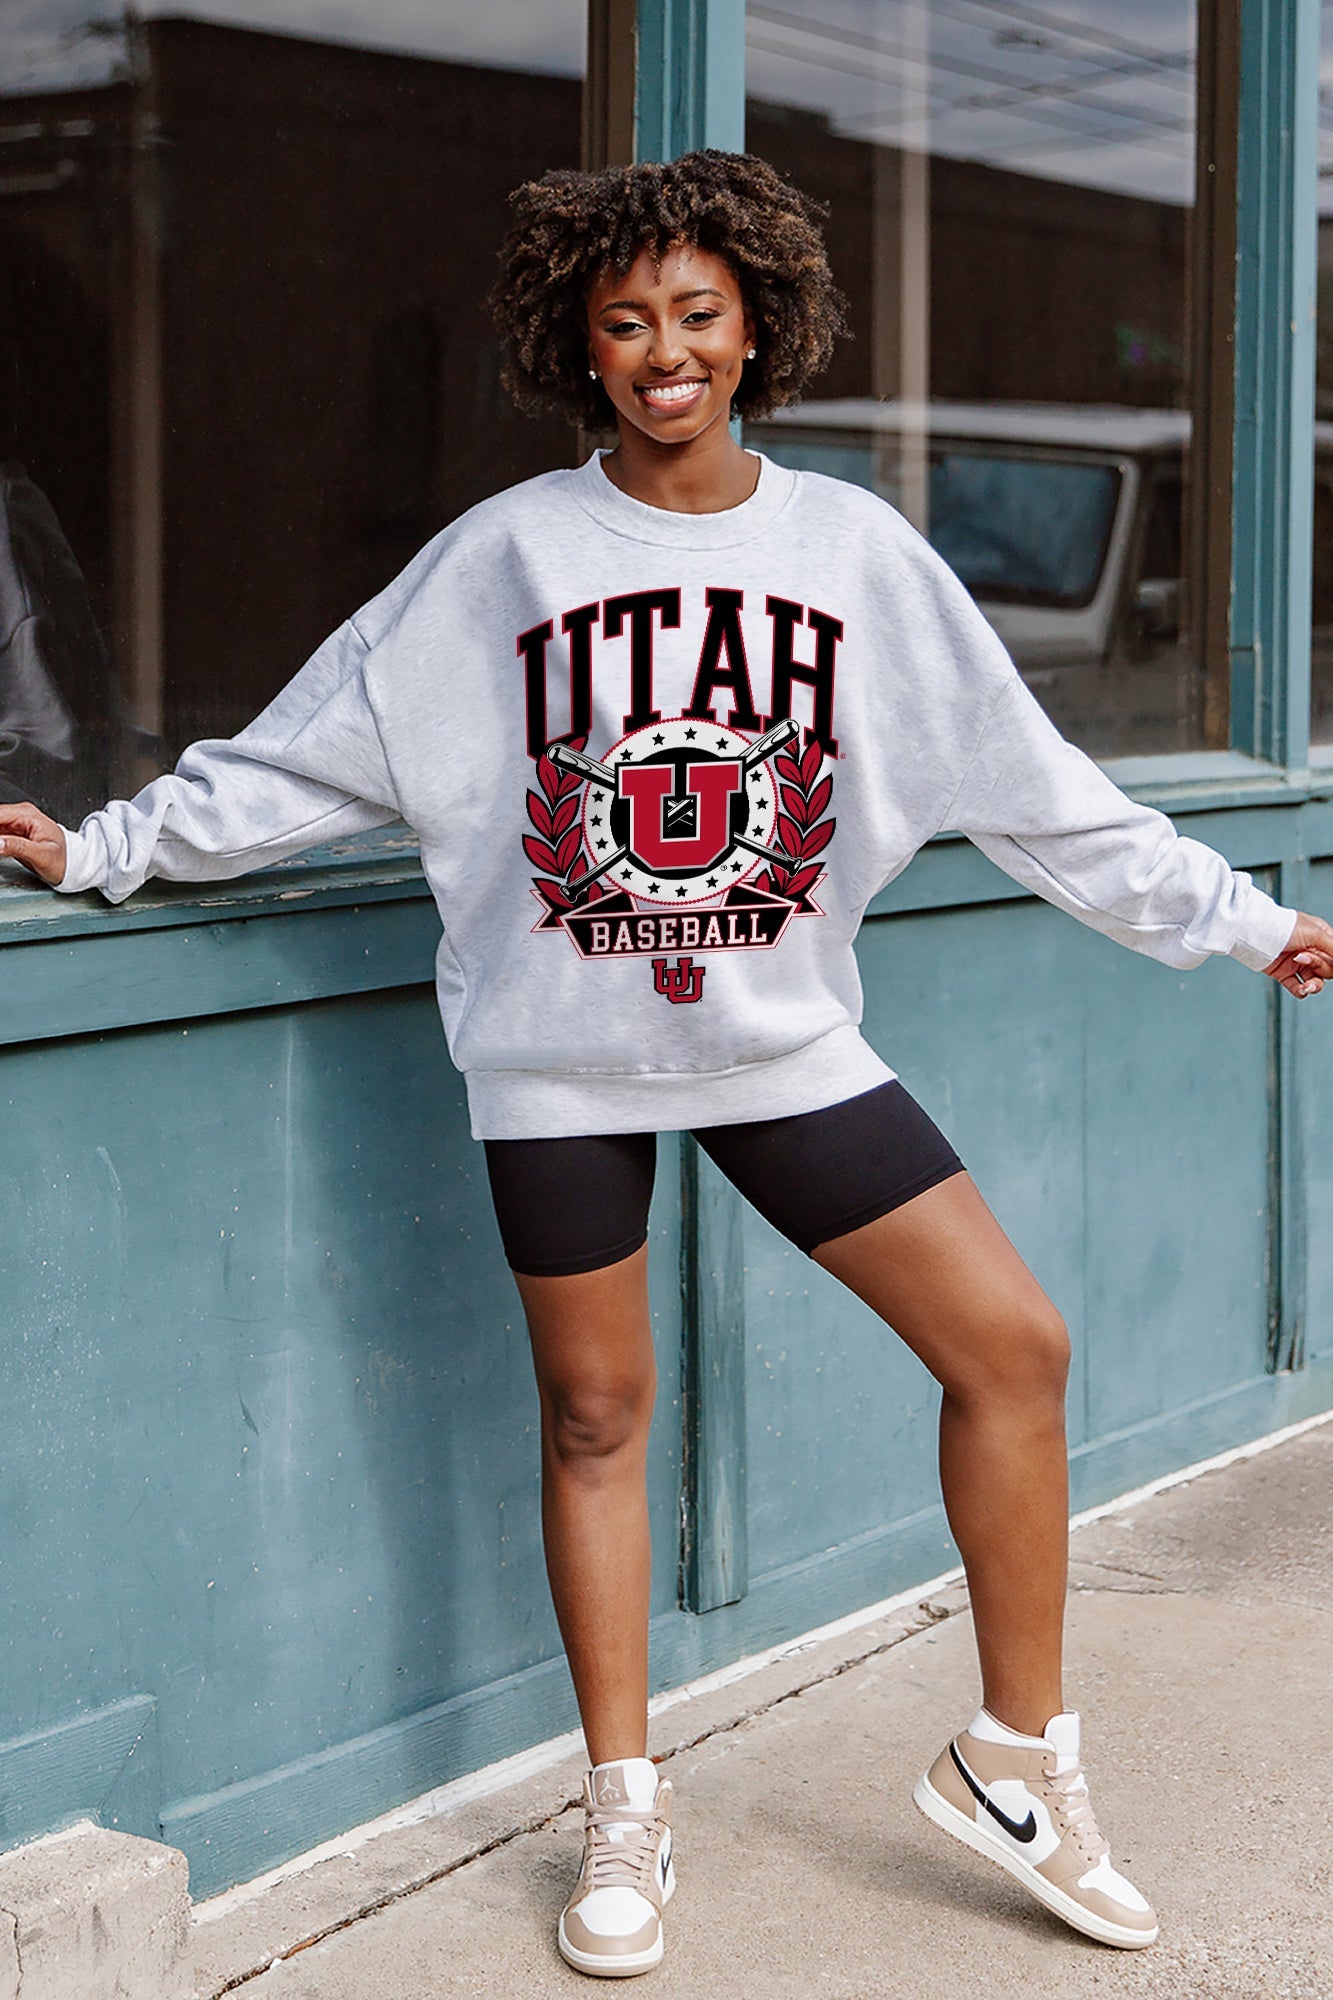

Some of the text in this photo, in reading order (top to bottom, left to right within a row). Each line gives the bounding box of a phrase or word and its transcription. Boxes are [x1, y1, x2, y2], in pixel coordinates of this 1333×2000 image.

[517, 586, 844, 761] UTAH
[615, 757, 744, 871] U
[590, 913, 768, 952] BASEBALL
